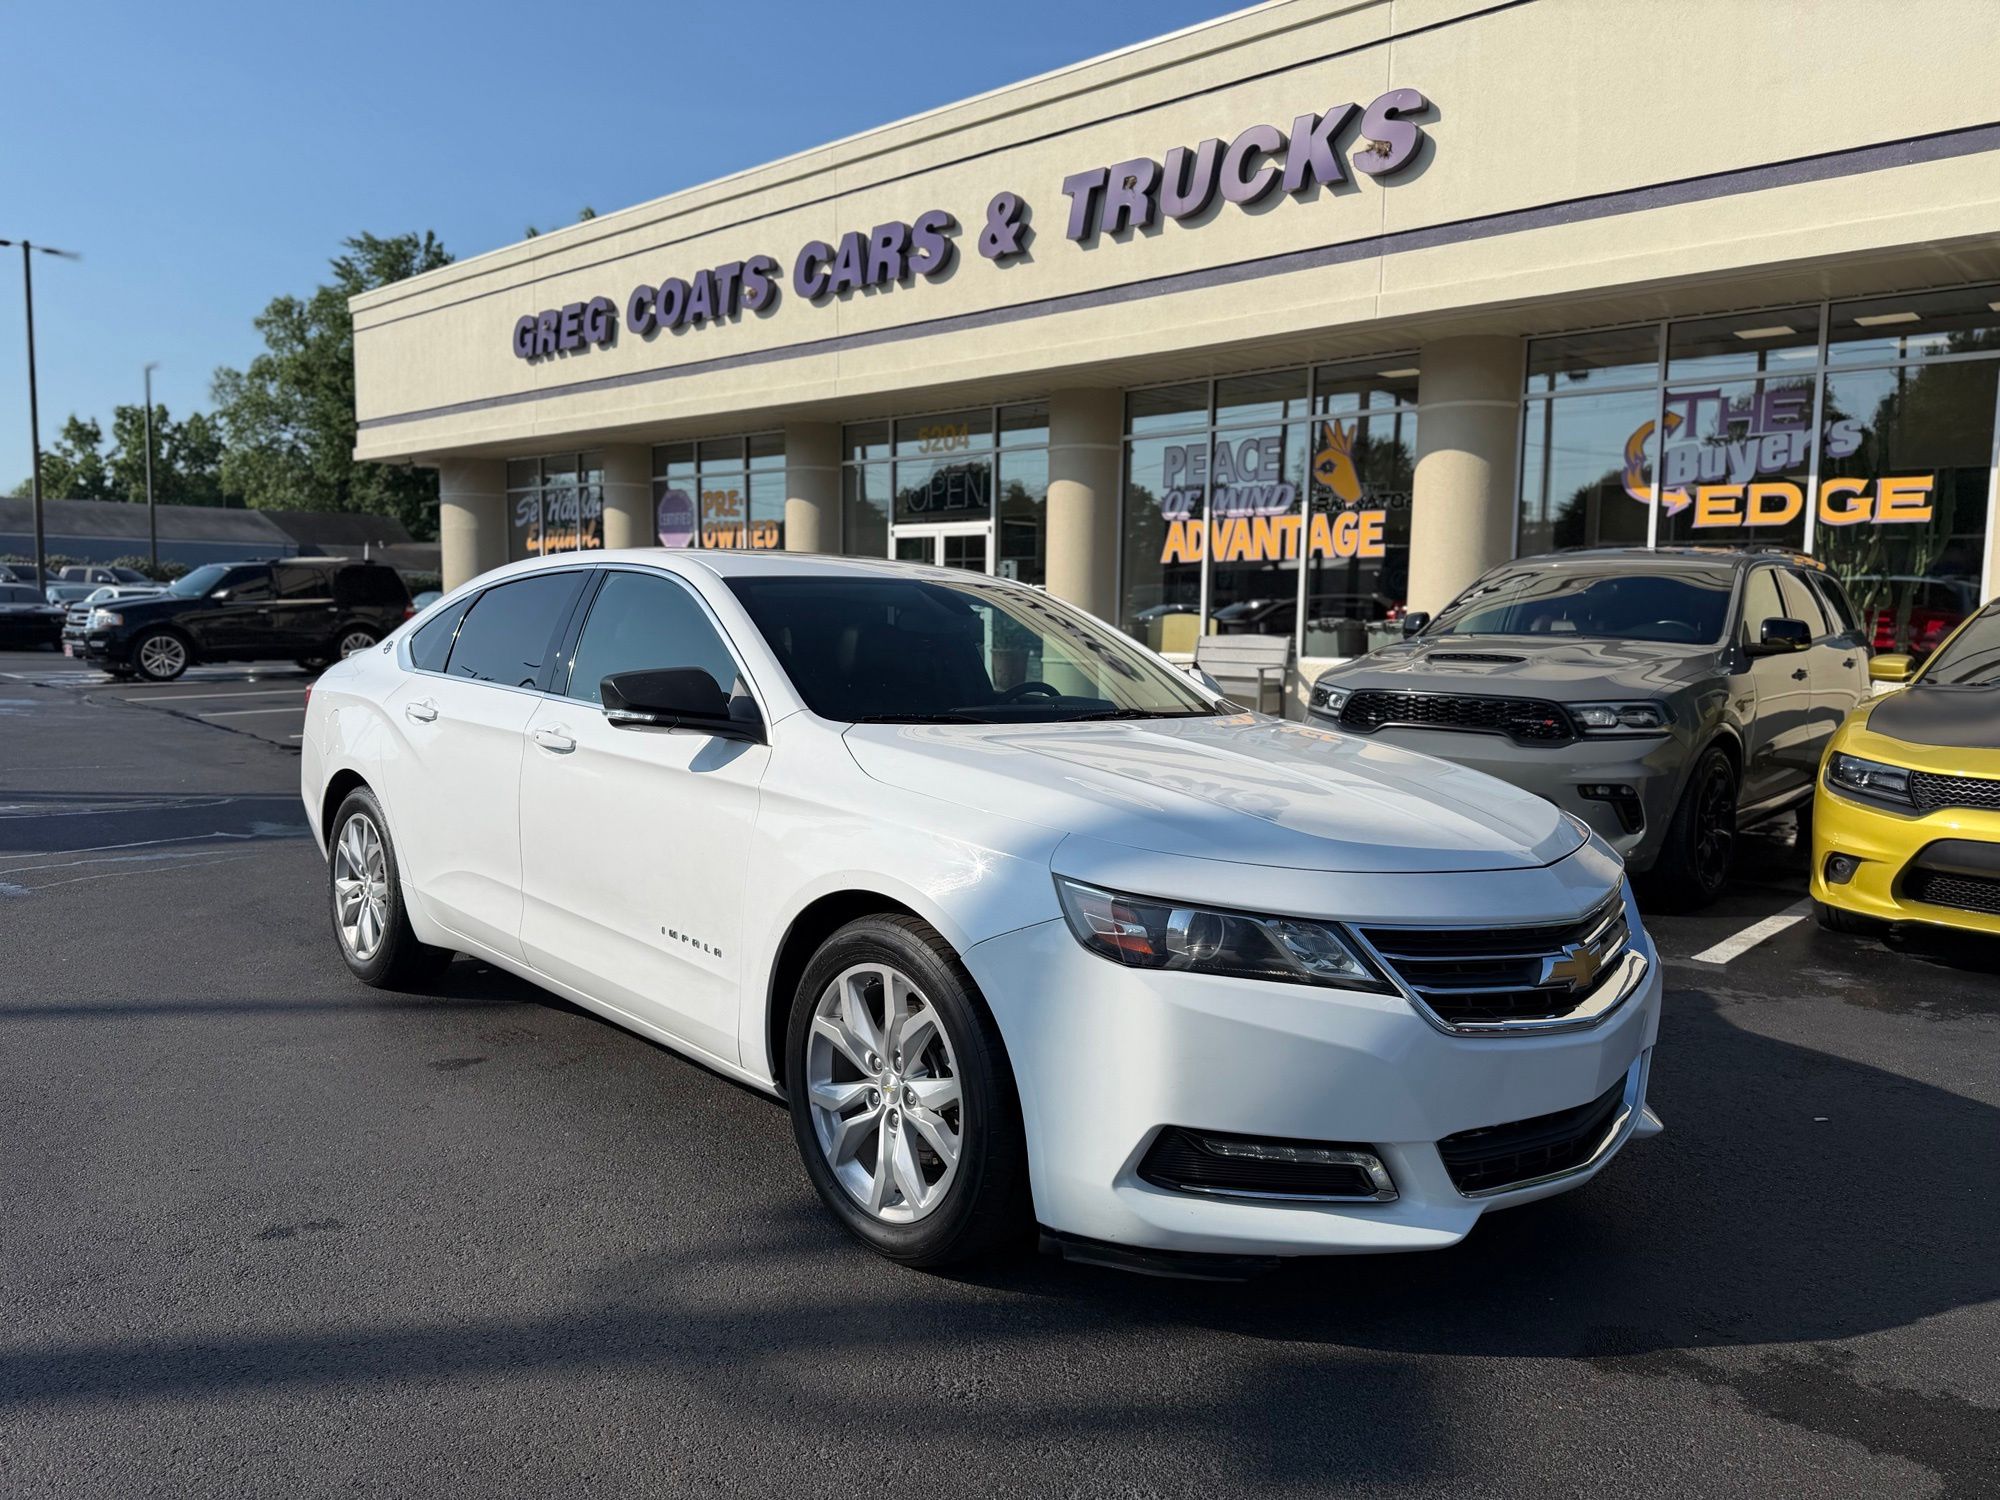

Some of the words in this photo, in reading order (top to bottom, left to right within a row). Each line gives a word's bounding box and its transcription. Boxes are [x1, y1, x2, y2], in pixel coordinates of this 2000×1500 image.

[513, 297, 616, 359] GREG
[627, 255, 779, 335] COATS
[793, 209, 956, 299] CARS
[978, 191, 1030, 260] &
[1062, 88, 1429, 241] TRUCKS
[917, 424, 970, 453] 5204
[1665, 388, 1809, 439] THE
[1163, 436, 1281, 488] PEACE
[908, 471, 987, 512] OPEN
[1161, 488, 1202, 520] OF
[1212, 482, 1297, 518] MIND
[1691, 474, 1935, 529] EDGE
[1160, 510, 1386, 564] ADVANTAGE
[661, 926, 722, 958] IMPALA
